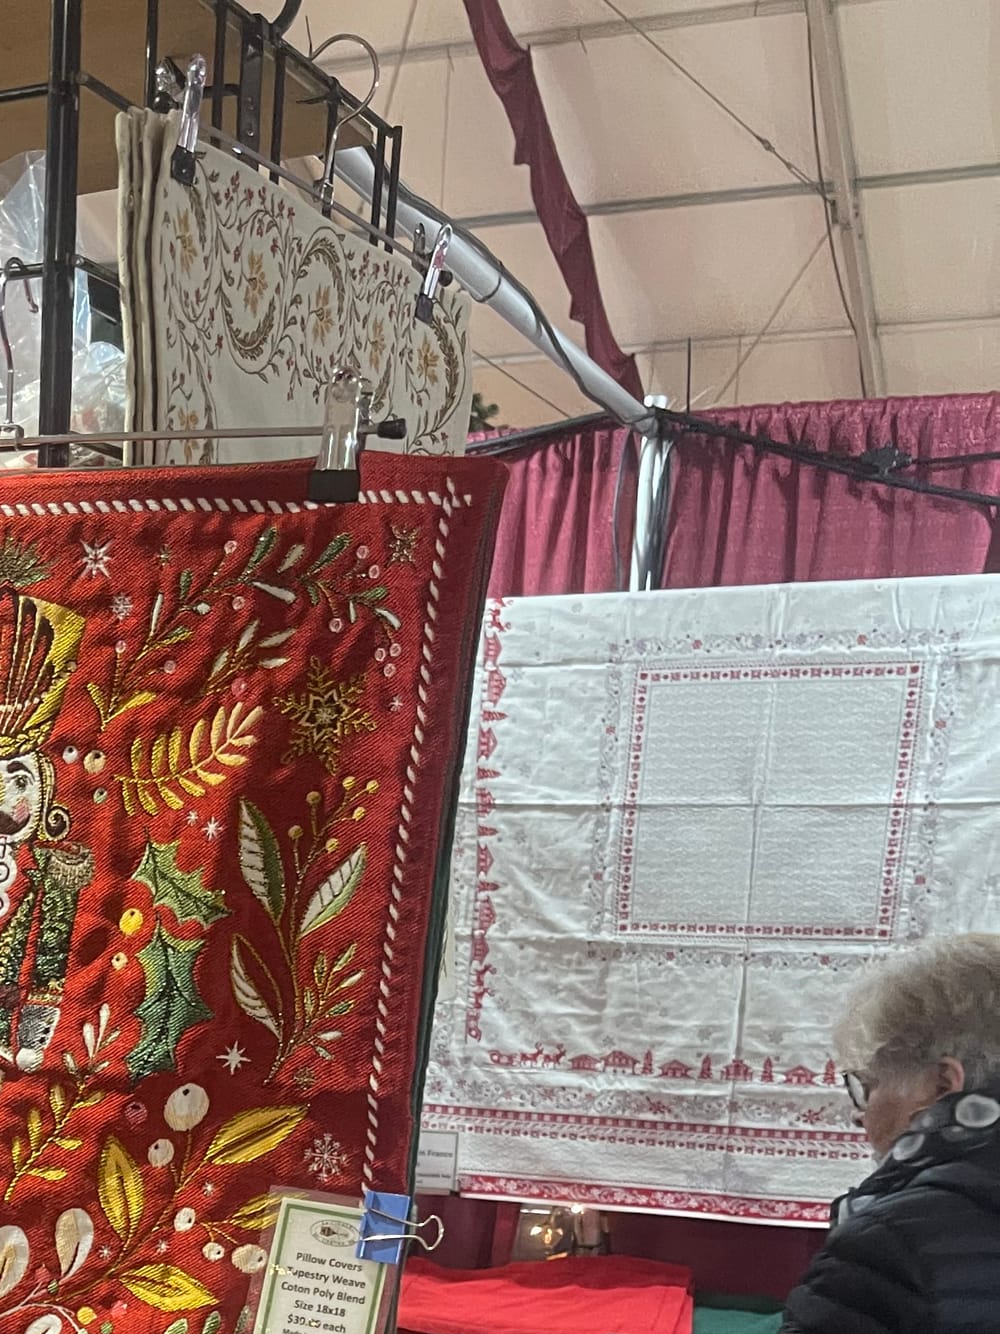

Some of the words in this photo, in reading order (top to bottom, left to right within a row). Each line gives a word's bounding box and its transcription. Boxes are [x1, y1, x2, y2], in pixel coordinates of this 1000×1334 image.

[296, 1252, 327, 1265] Pillow
[329, 1258, 363, 1272] Covers
[332, 1274, 366, 1289] Weave
[281, 1281, 310, 1295] Coton
[313, 1287, 335, 1300] Poly
[337, 1291, 366, 1305] Blend
[293, 1299, 314, 1311] Size
[316, 1304, 346, 1317] 18x18
[323, 1322, 346, 1333] each
